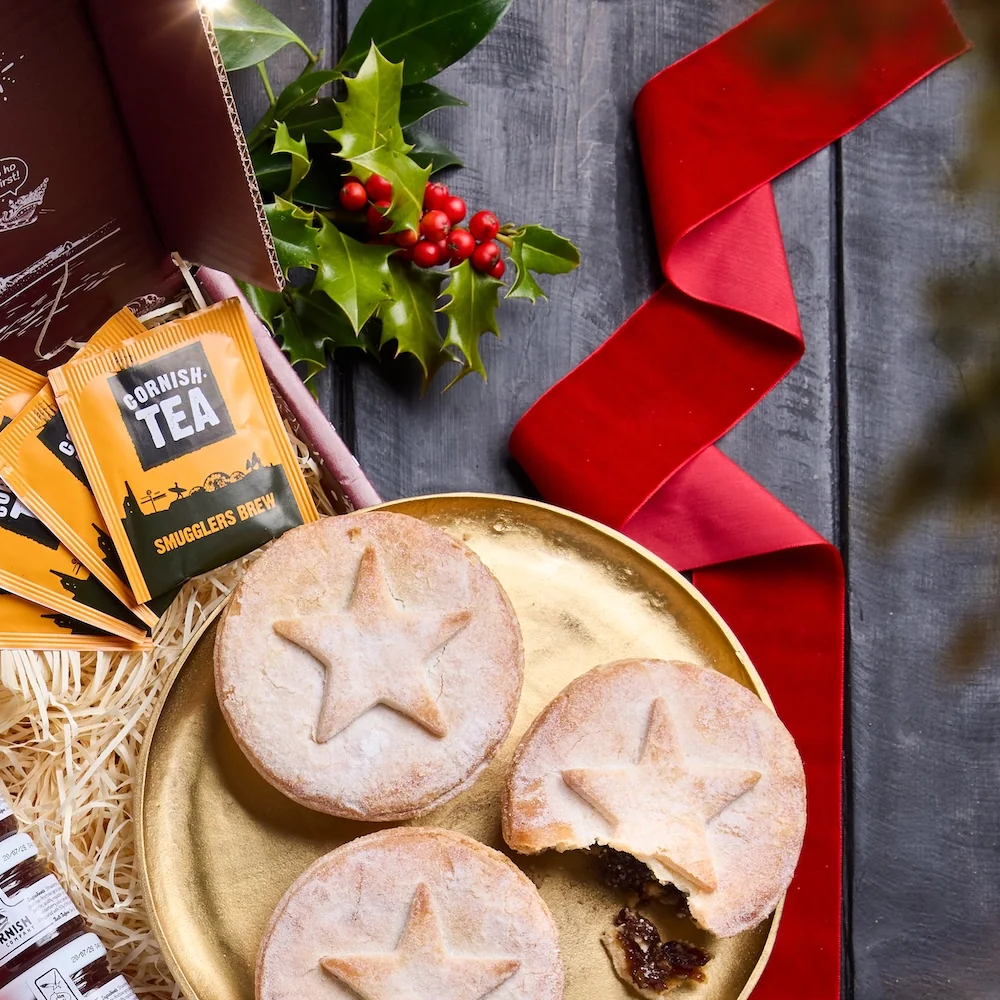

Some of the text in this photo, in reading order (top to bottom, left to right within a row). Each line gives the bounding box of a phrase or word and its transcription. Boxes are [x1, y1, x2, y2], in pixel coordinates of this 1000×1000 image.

[3, 163, 16, 174] ho
[134, 386, 221, 449] TEA
[153, 492, 277, 555] SMUGGLERS BREW
[5, 925, 35, 948] COMPANY
